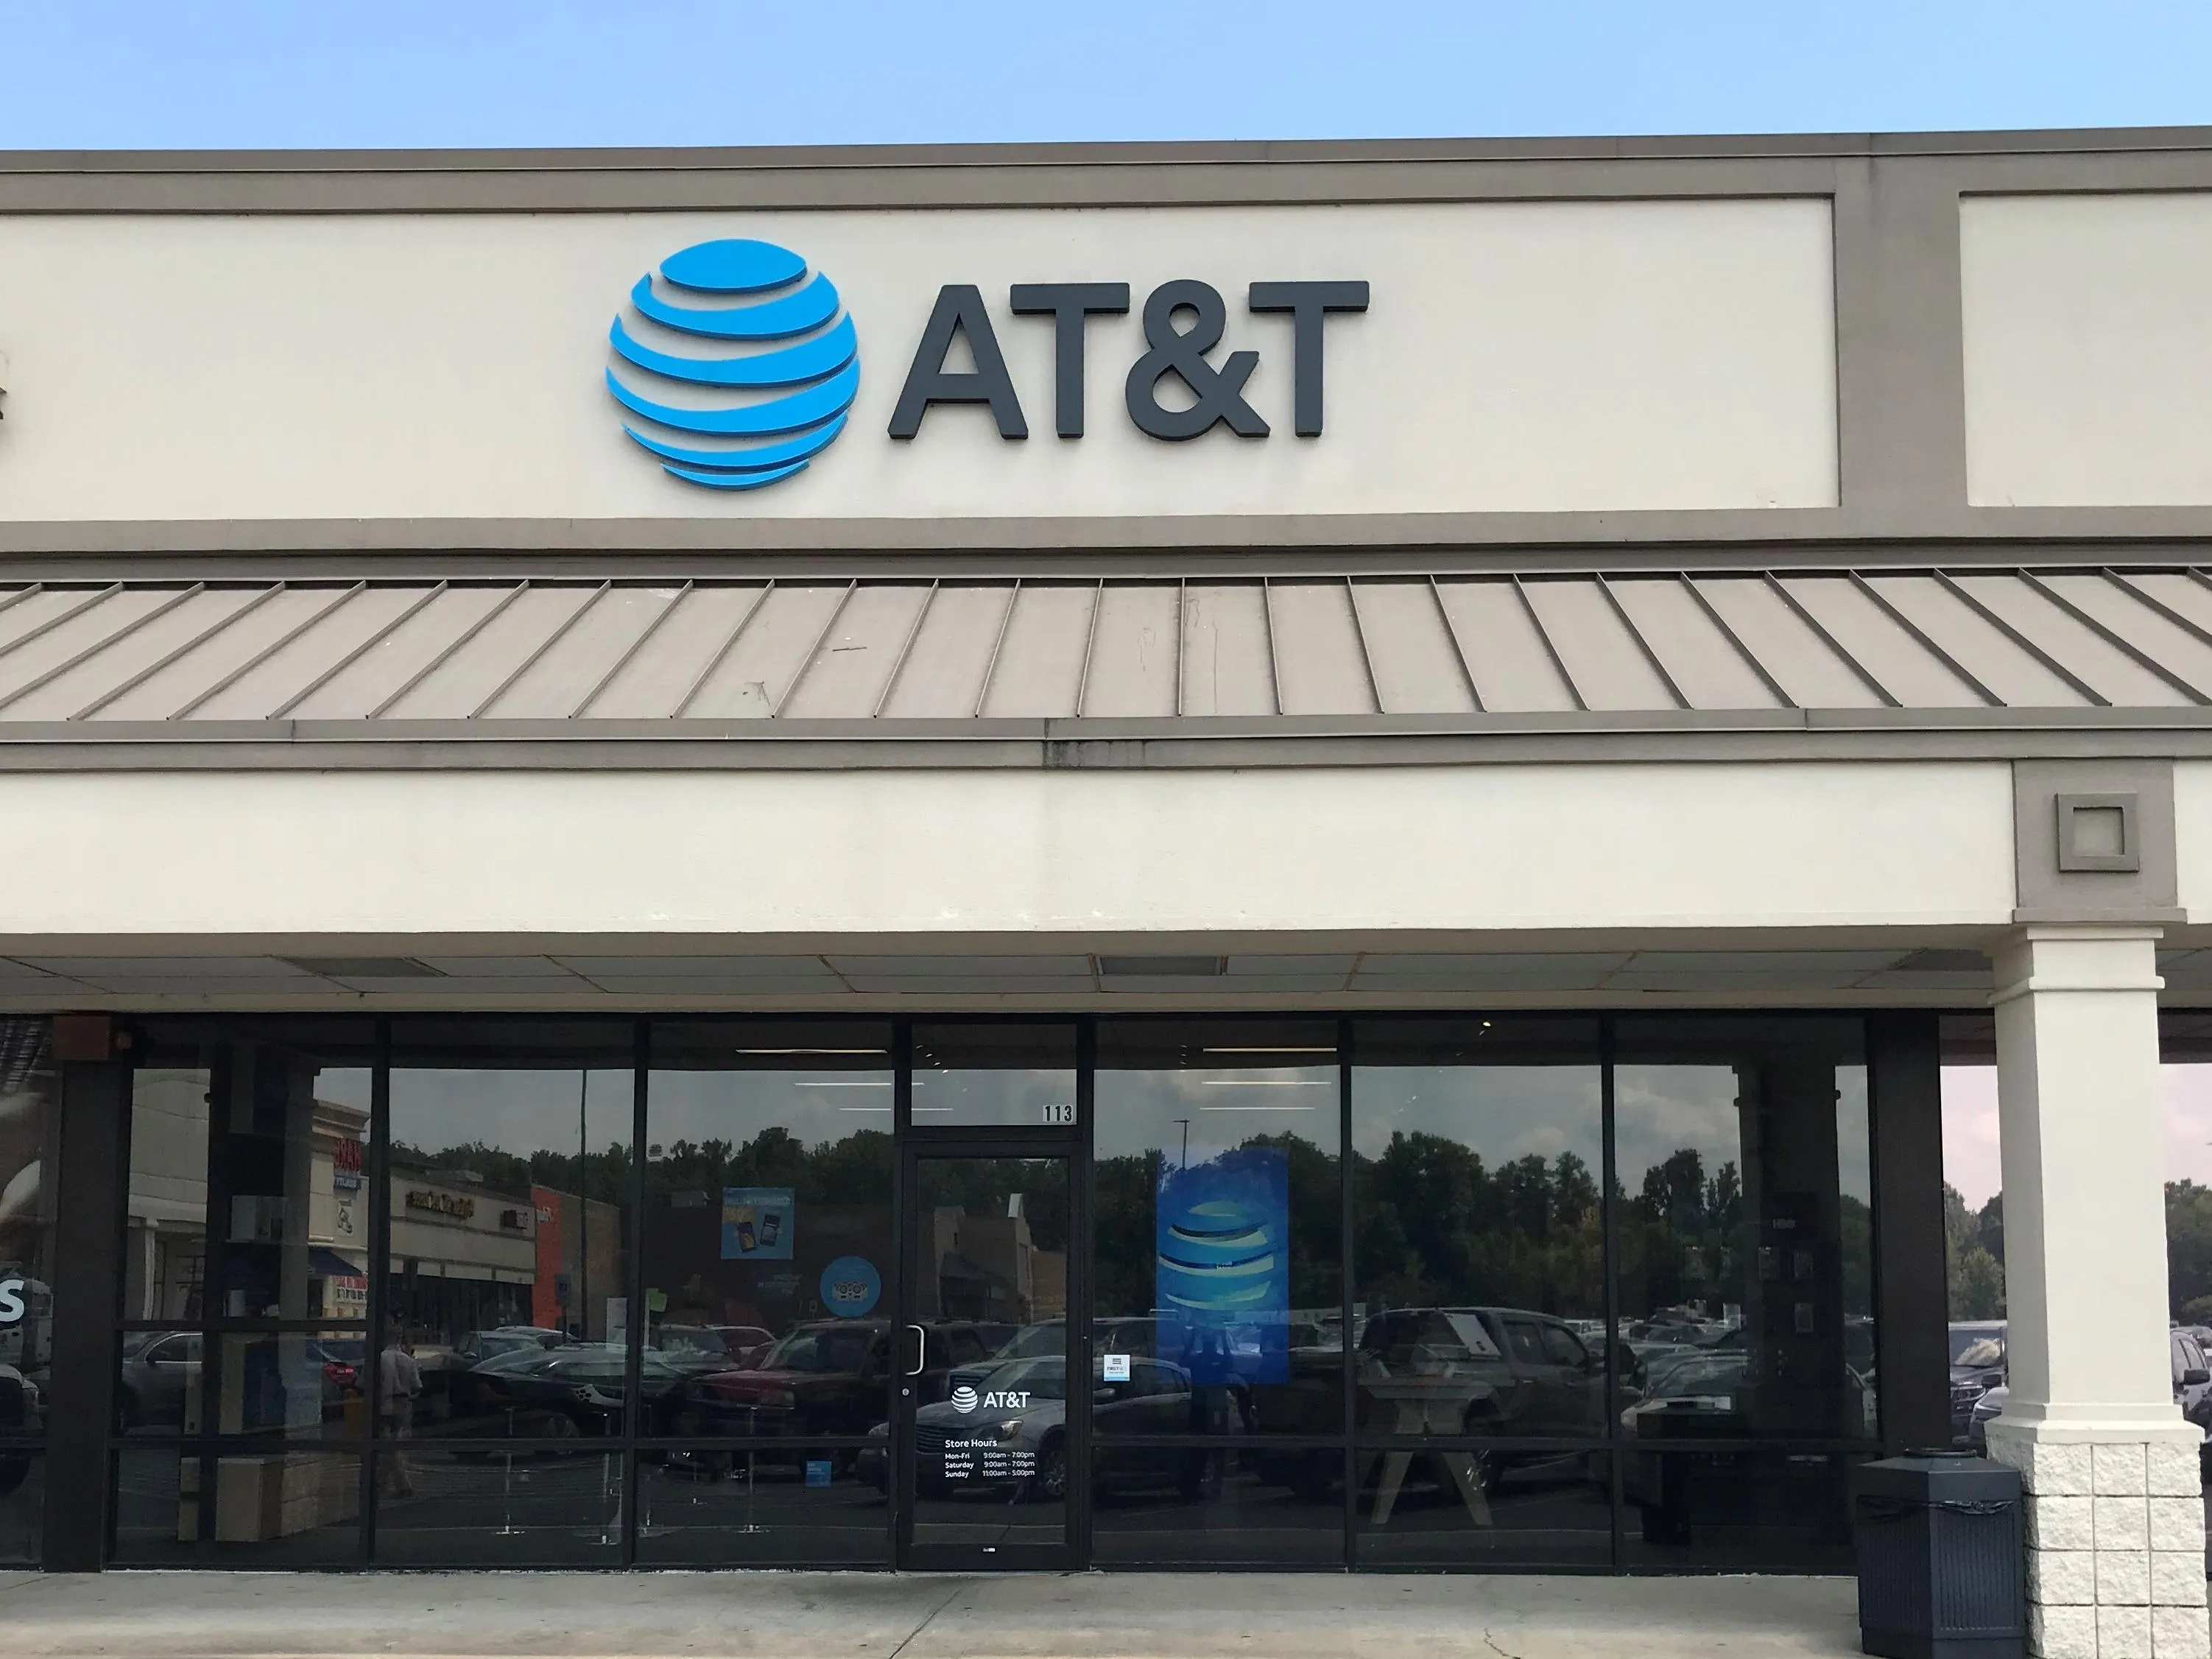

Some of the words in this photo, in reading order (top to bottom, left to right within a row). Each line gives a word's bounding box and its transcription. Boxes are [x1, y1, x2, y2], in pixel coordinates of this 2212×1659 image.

[887, 278, 1370, 442] AT&T
[1045, 1105, 1072, 1122] 113
[983, 1391, 1031, 1409] AT&T
[945, 1439, 970, 1448] Store
[971, 1438, 998, 1448] Hours
[945, 1470, 970, 1479] Sunday
